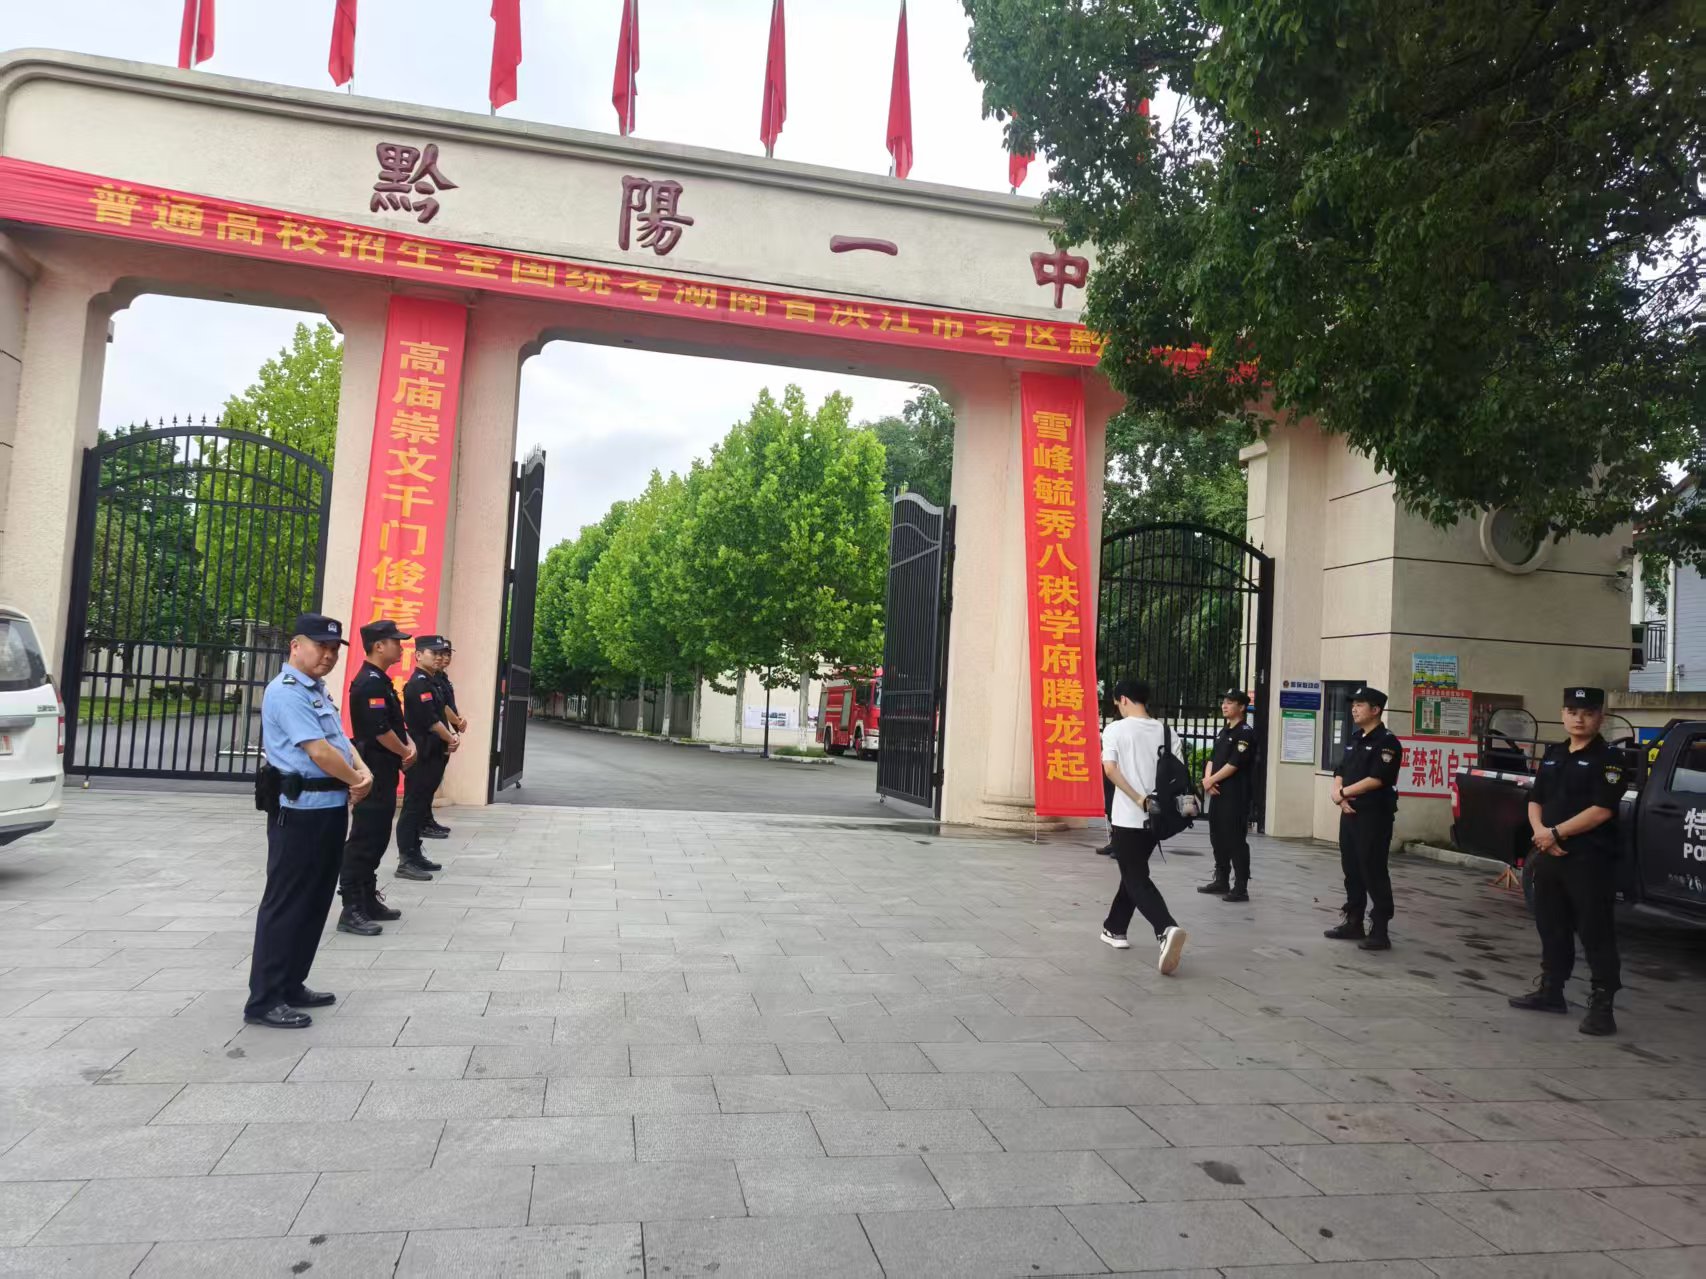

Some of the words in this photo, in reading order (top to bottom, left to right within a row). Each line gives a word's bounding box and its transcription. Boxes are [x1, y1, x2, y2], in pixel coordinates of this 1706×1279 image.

[369, 340, 450, 712] 高庙崇文千门俊彦
[1032, 410, 1090, 783] 雪峰毓秀八秩学府腾龙起
